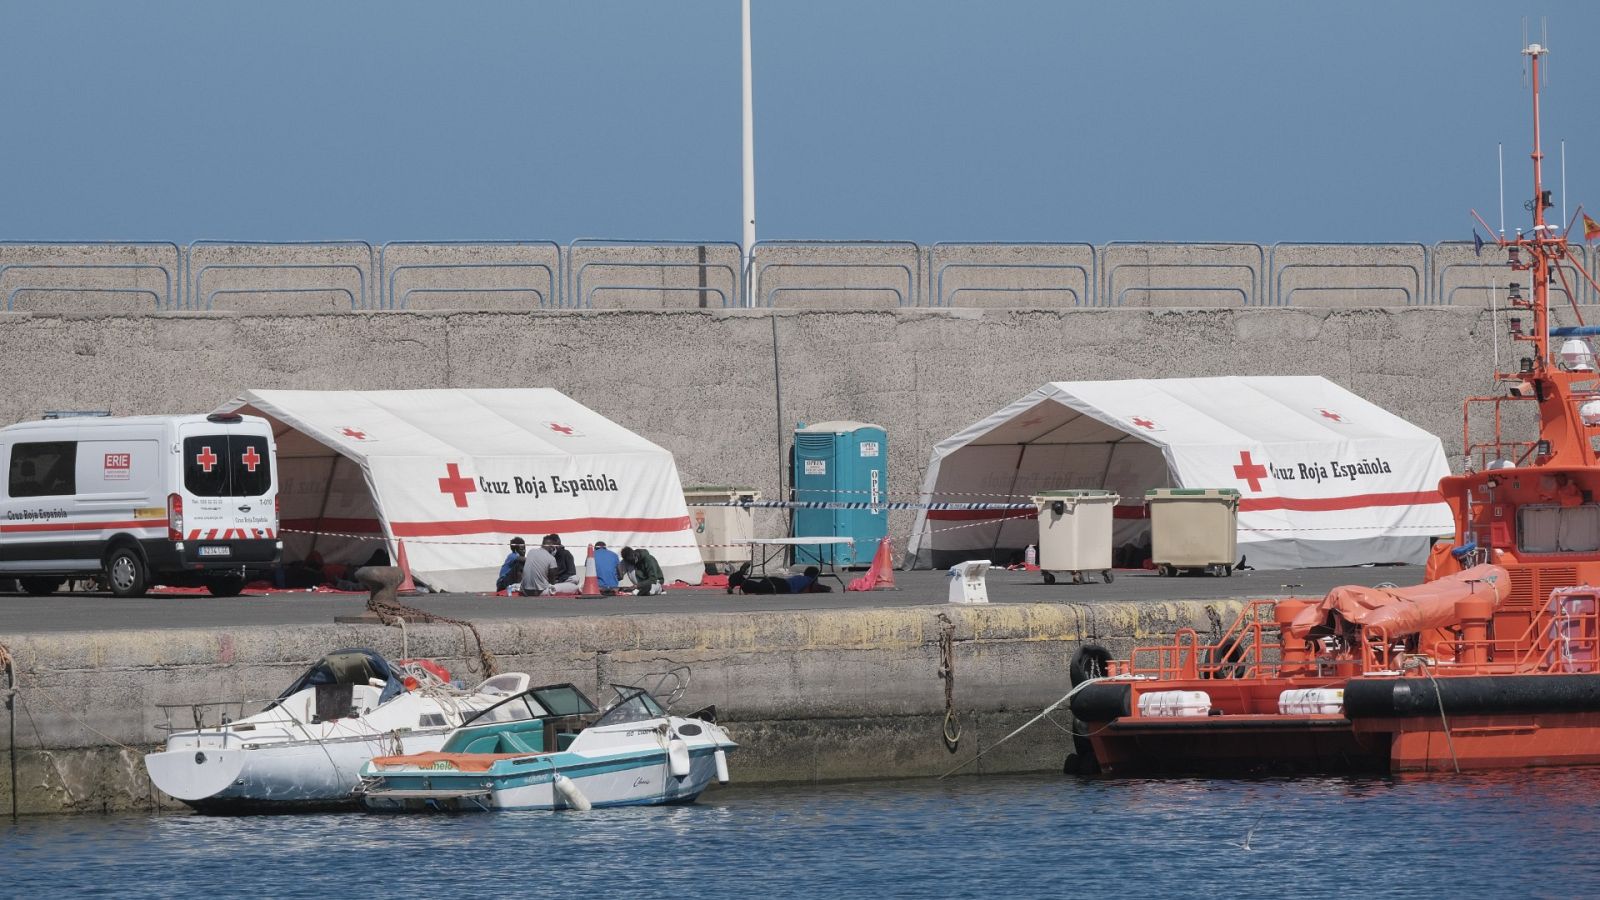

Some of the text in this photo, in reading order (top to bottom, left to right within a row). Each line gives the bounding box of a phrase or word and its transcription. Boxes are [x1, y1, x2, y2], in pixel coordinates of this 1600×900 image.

[106, 455, 129, 467] ERIE
[1298, 462, 1329, 484] Roja
[1330, 457, 1392, 481] Española
[479, 474, 618, 498] Cruz Roja Española
[8, 508, 67, 522] Cruz Roja Española
